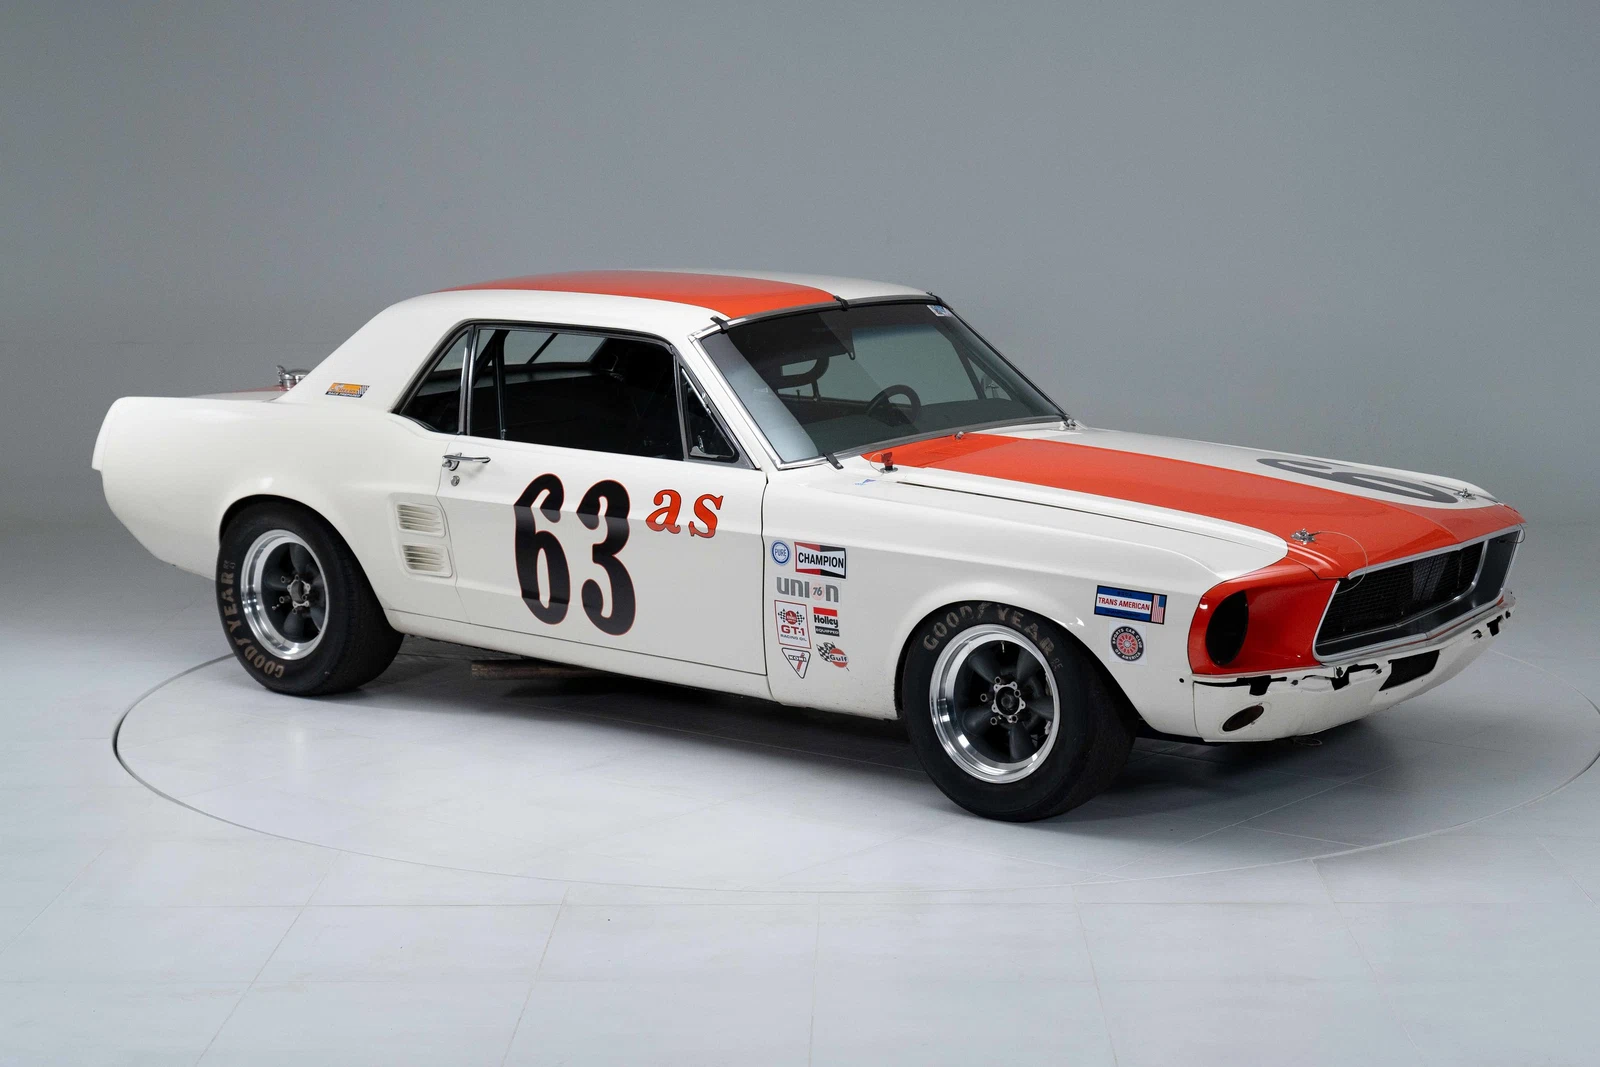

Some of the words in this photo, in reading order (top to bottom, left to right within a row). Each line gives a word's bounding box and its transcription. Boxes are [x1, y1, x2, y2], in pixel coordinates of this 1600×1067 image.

[513, 473, 636, 636] 63
[645, 489, 724, 538] as
[798, 552, 844, 569] CHAMPION
[1098, 596, 1118, 606] TRANS
[1118, 600, 1150, 611] AMERICAN
[814, 615, 839, 628] Holley
[780, 633, 799, 641] RACING
[1112, 627, 1125, 645] SPORTS
[1125, 627, 1136, 635] CAR
[1135, 634, 1143, 648] CLUB
[829, 654, 848, 662] Gulf
[1121, 652, 1142, 660] AMERICA
